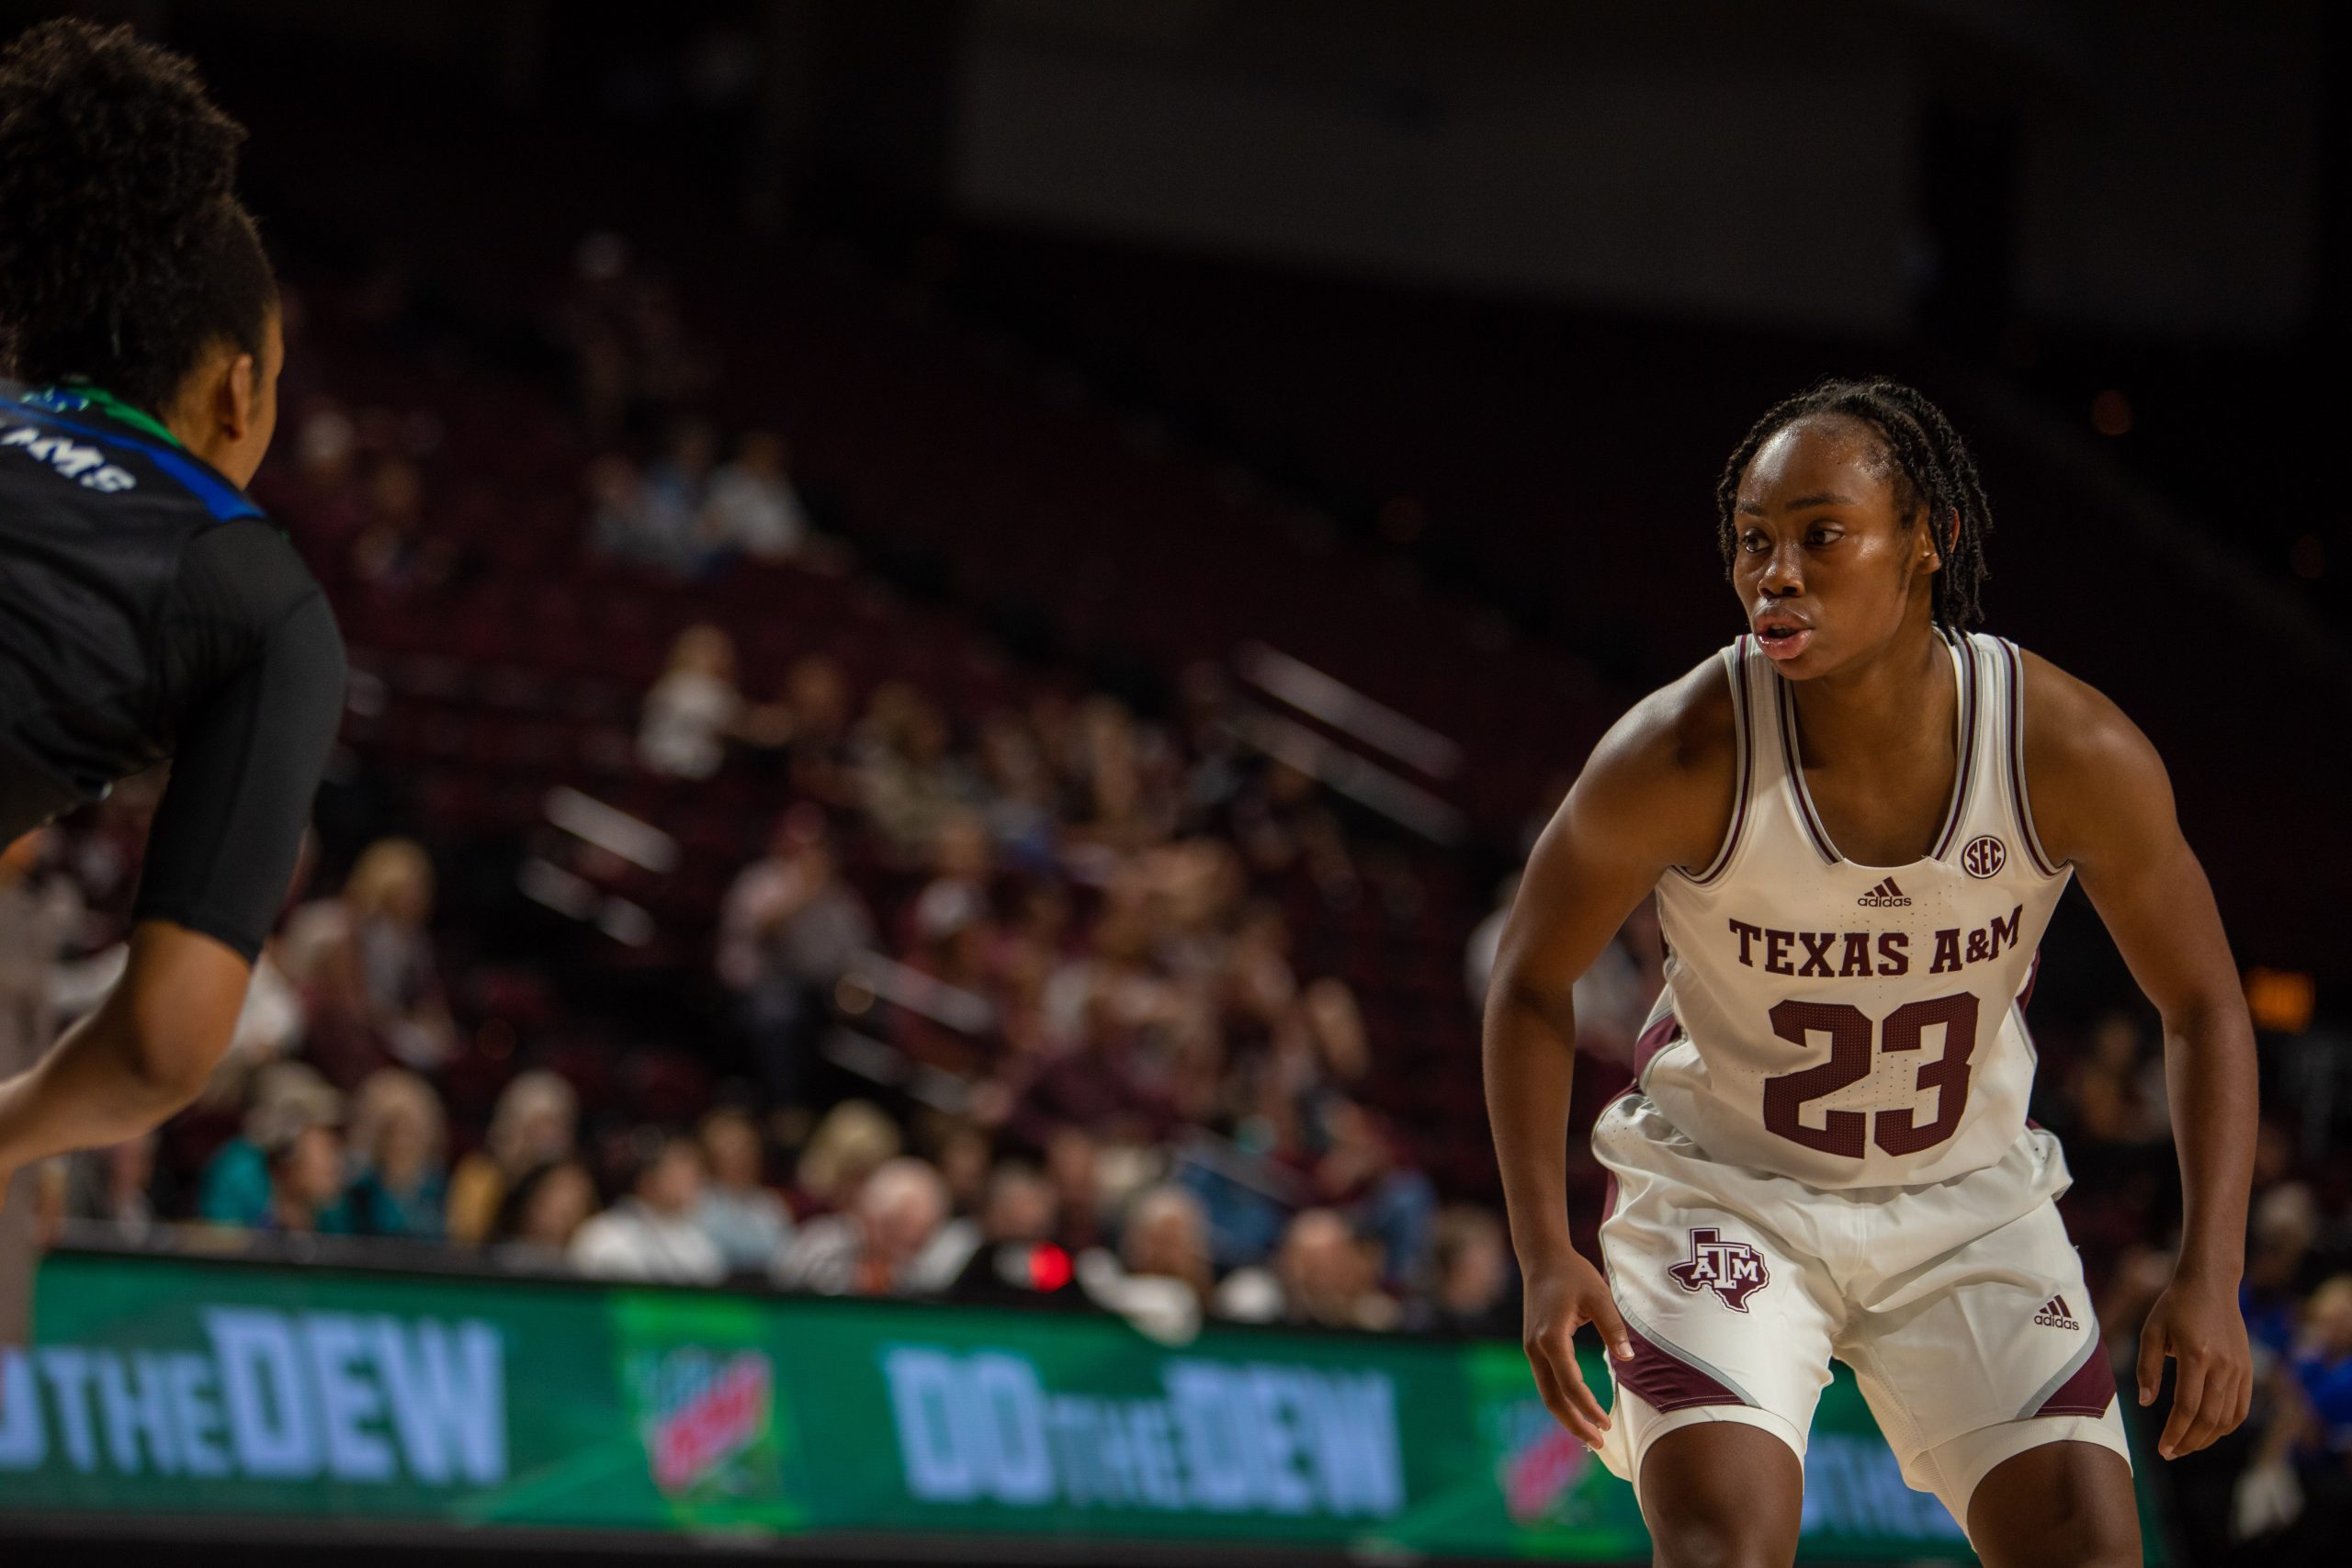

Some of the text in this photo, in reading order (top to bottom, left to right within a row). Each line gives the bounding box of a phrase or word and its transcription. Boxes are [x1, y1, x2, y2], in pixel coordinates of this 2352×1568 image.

[1966, 839, 2003, 875] SEC
[1857, 896, 1912, 908] adidas
[1729, 903, 2023, 978] TEXAS A&M
[1763, 991, 1980, 1159] 23
[2033, 1314, 2080, 1331] adidas
[202, 1304, 510, 1488] DEW
